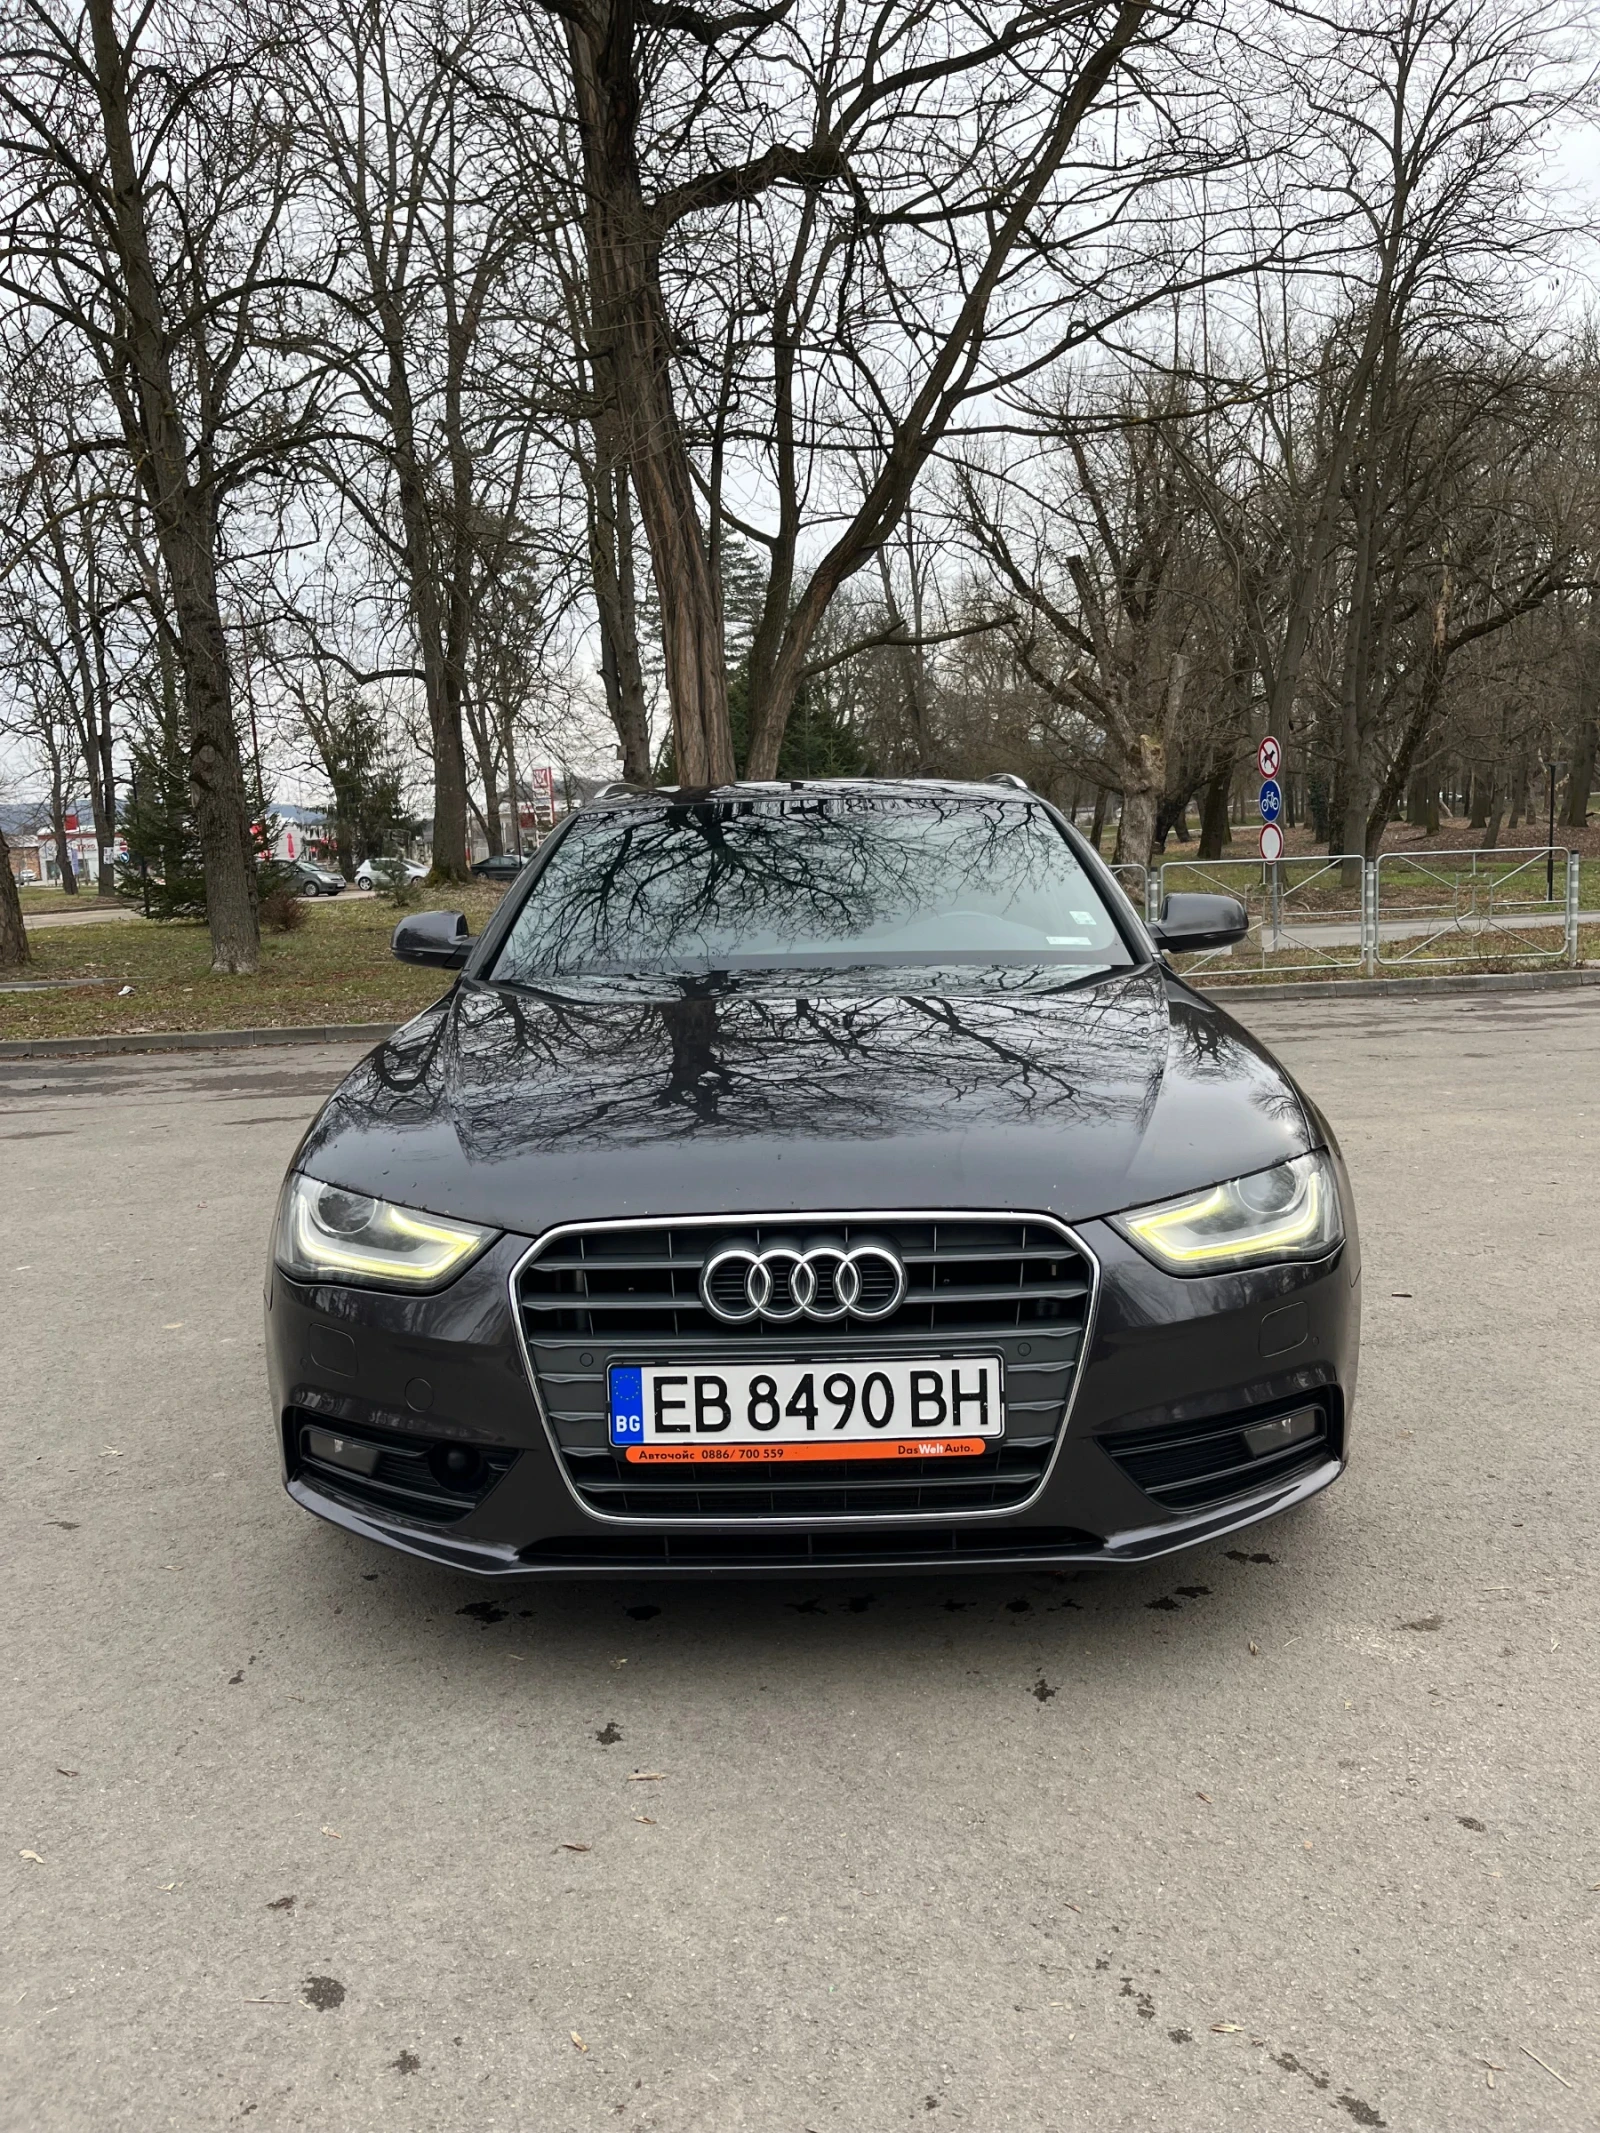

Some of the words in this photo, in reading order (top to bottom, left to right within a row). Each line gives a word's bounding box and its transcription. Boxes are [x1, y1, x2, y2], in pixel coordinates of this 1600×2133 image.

[653, 1375, 732, 1434] EB
[747, 1371, 895, 1432] 8490
[910, 1368, 989, 1428] BH
[615, 1414, 641, 1433] BG
[638, 1450, 696, 1460] Авточойс
[701, 1449, 735, 1460] 0886/
[738, 1449, 760, 1459] 700
[763, 1448, 784, 1459] 559
